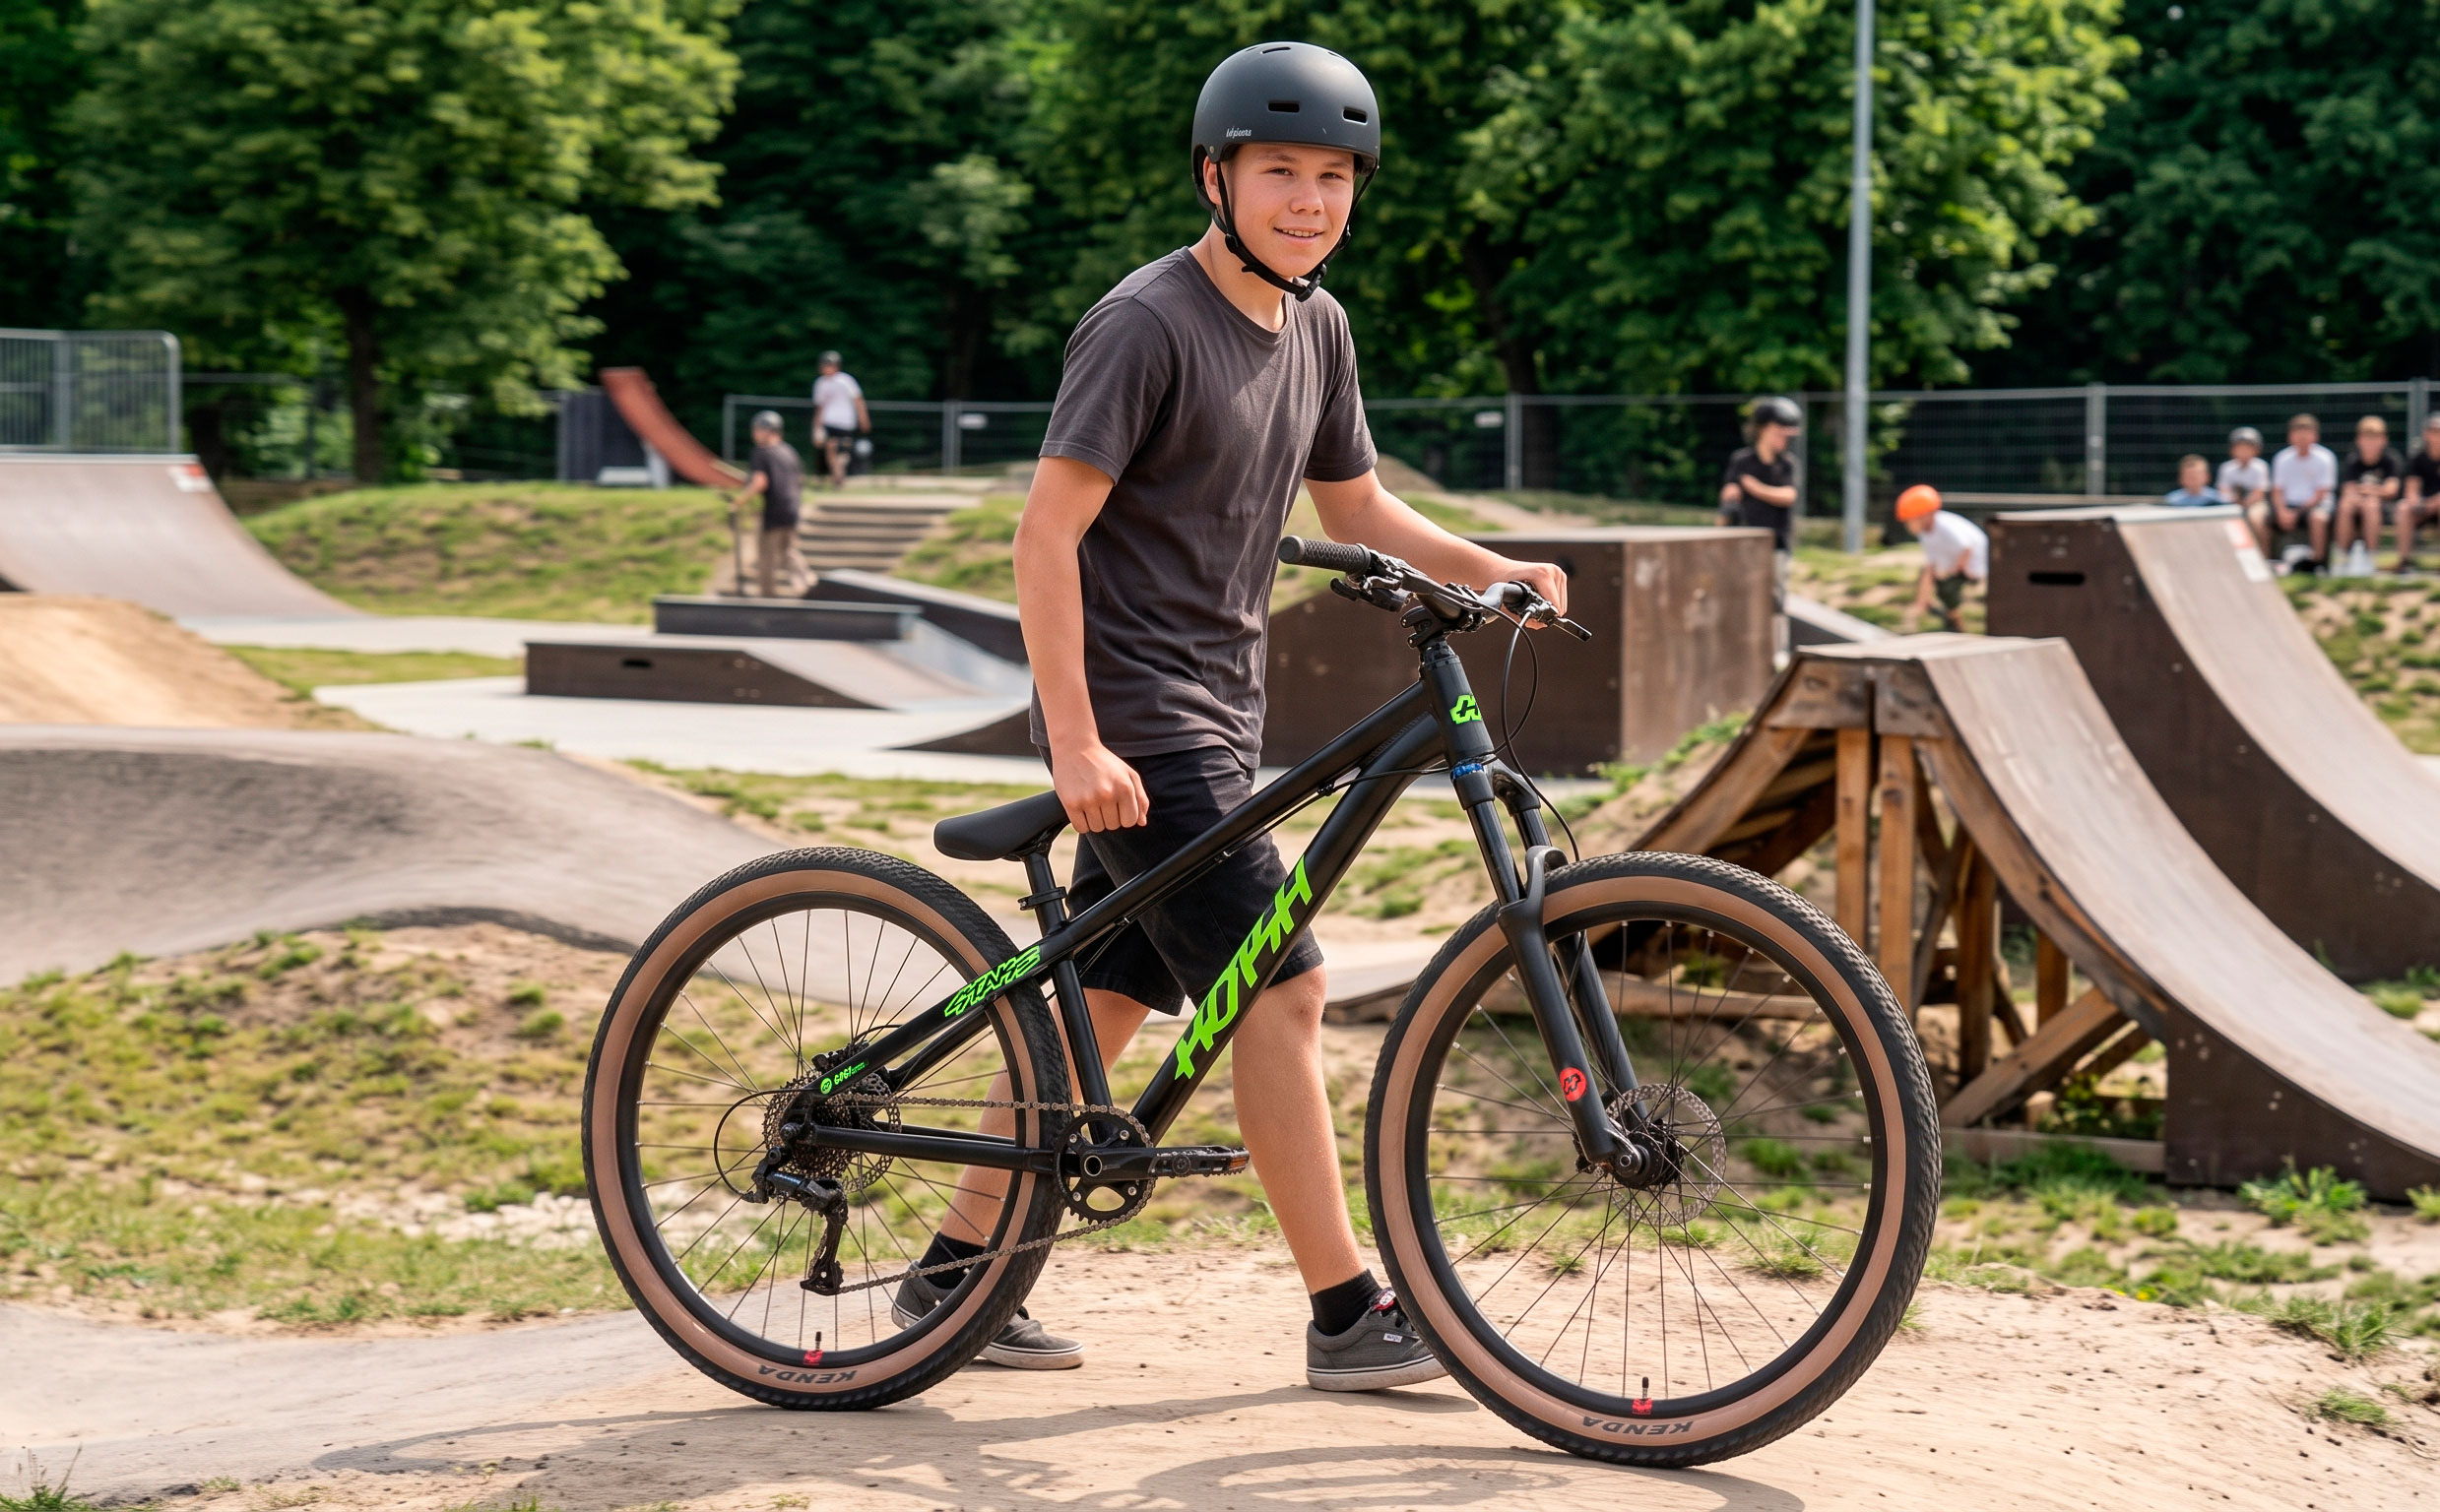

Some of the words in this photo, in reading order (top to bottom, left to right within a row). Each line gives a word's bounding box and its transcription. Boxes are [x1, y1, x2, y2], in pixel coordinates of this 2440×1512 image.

[943, 945, 1041, 1018] STAKE
[758, 1364, 858, 1384] KENDA
[1582, 1416, 1694, 1435] KENDA
